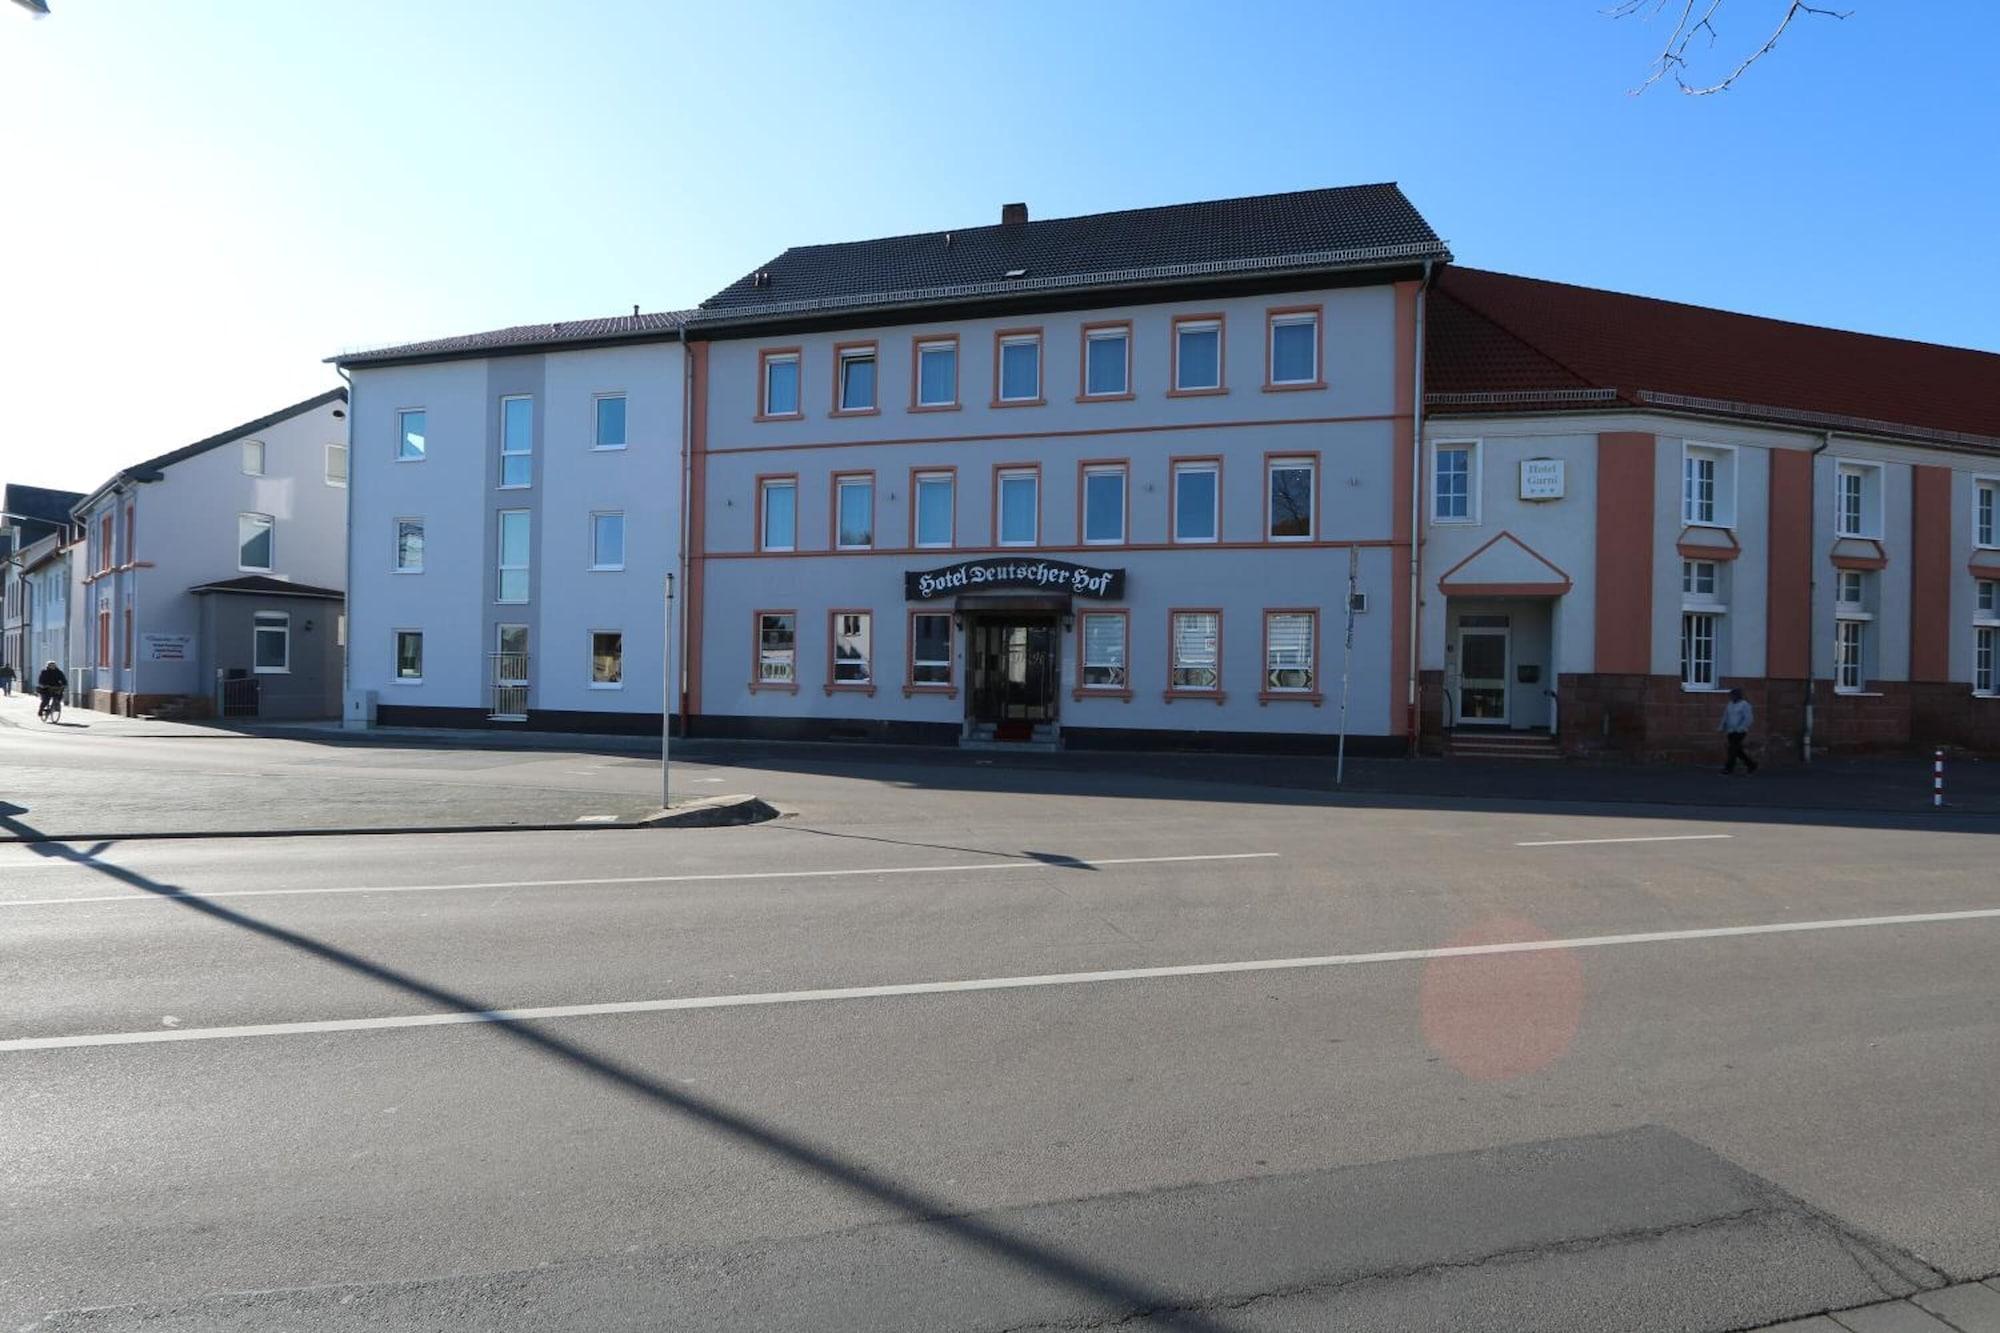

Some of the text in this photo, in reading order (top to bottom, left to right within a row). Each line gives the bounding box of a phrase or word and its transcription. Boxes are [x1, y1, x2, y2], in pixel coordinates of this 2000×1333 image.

[1529, 464, 1556, 473] Hotel
[1527, 475, 1558, 485] Garni
[919, 562, 1113, 597] Hotel Deutscher Hof
